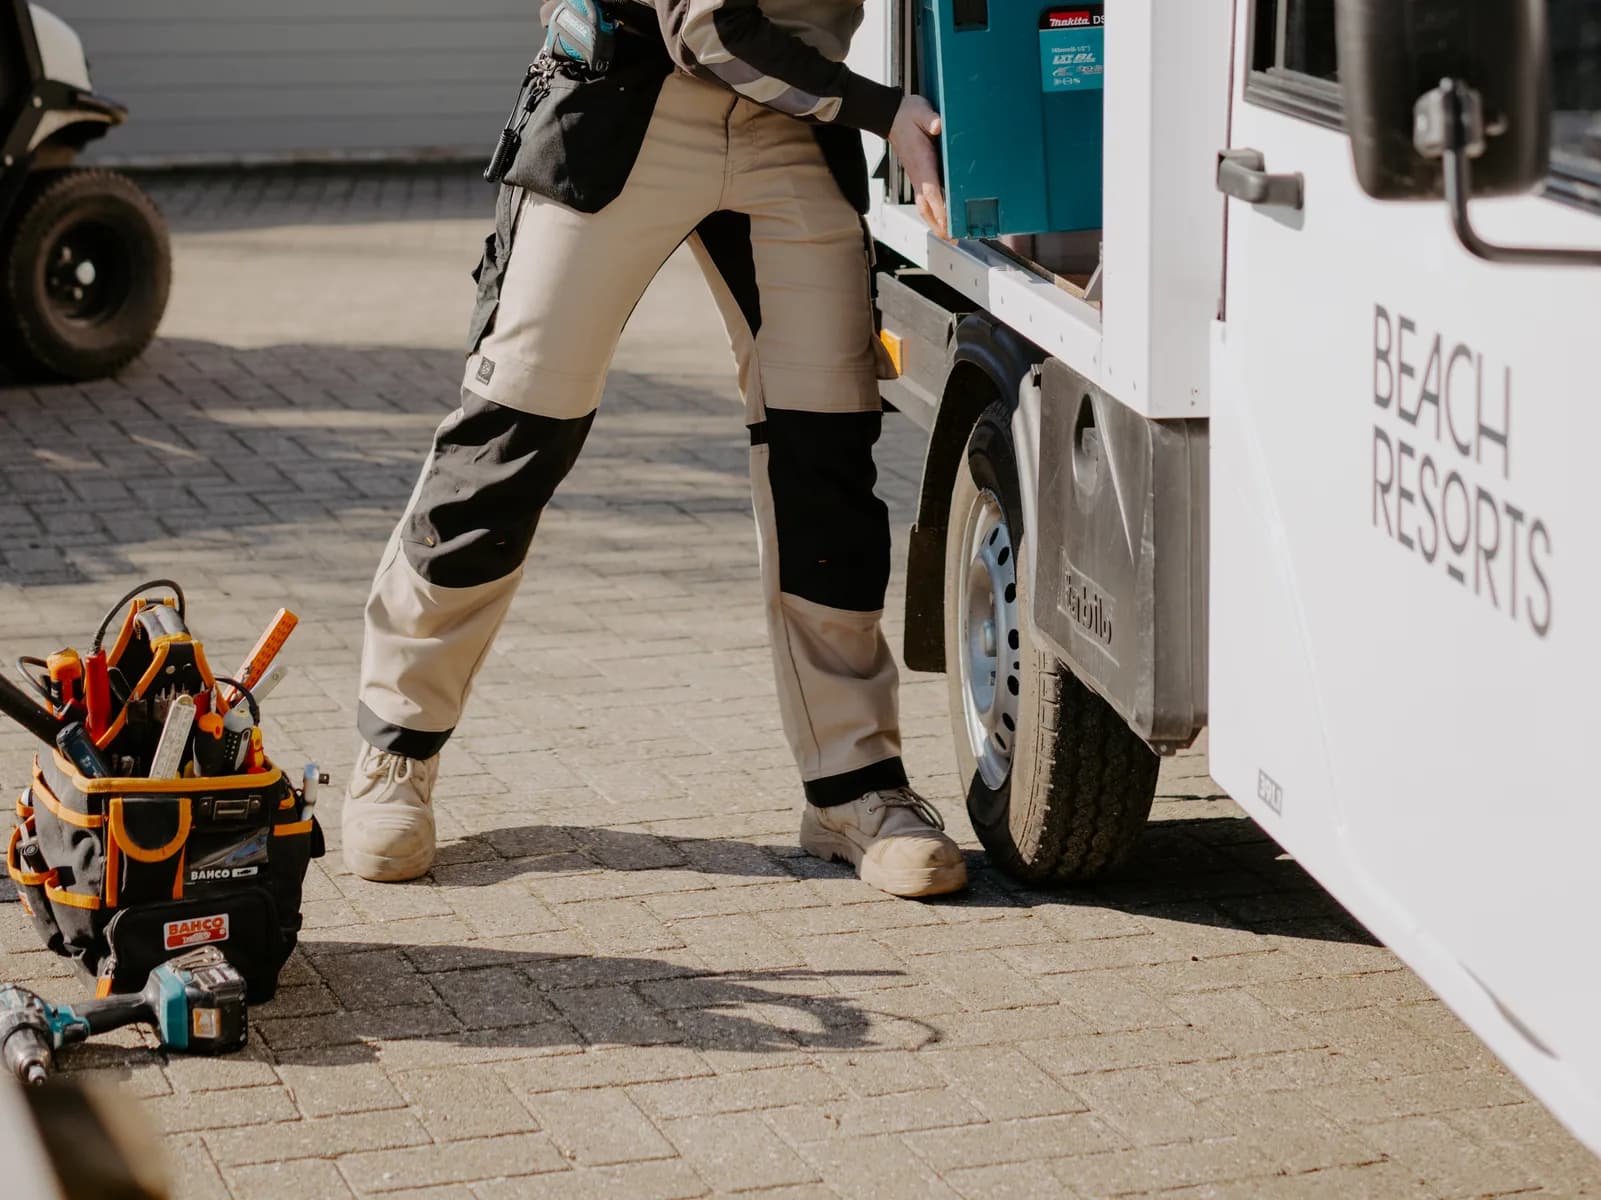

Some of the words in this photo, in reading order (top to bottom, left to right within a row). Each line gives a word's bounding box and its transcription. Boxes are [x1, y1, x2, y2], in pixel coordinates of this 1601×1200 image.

[1093, 15, 1105, 25] DS
[1373, 302, 1511, 481] BEACH
[1372, 424, 1553, 640] RESORTS
[190, 869, 231, 881] BAHCO
[168, 916, 225, 936] BAHCO
